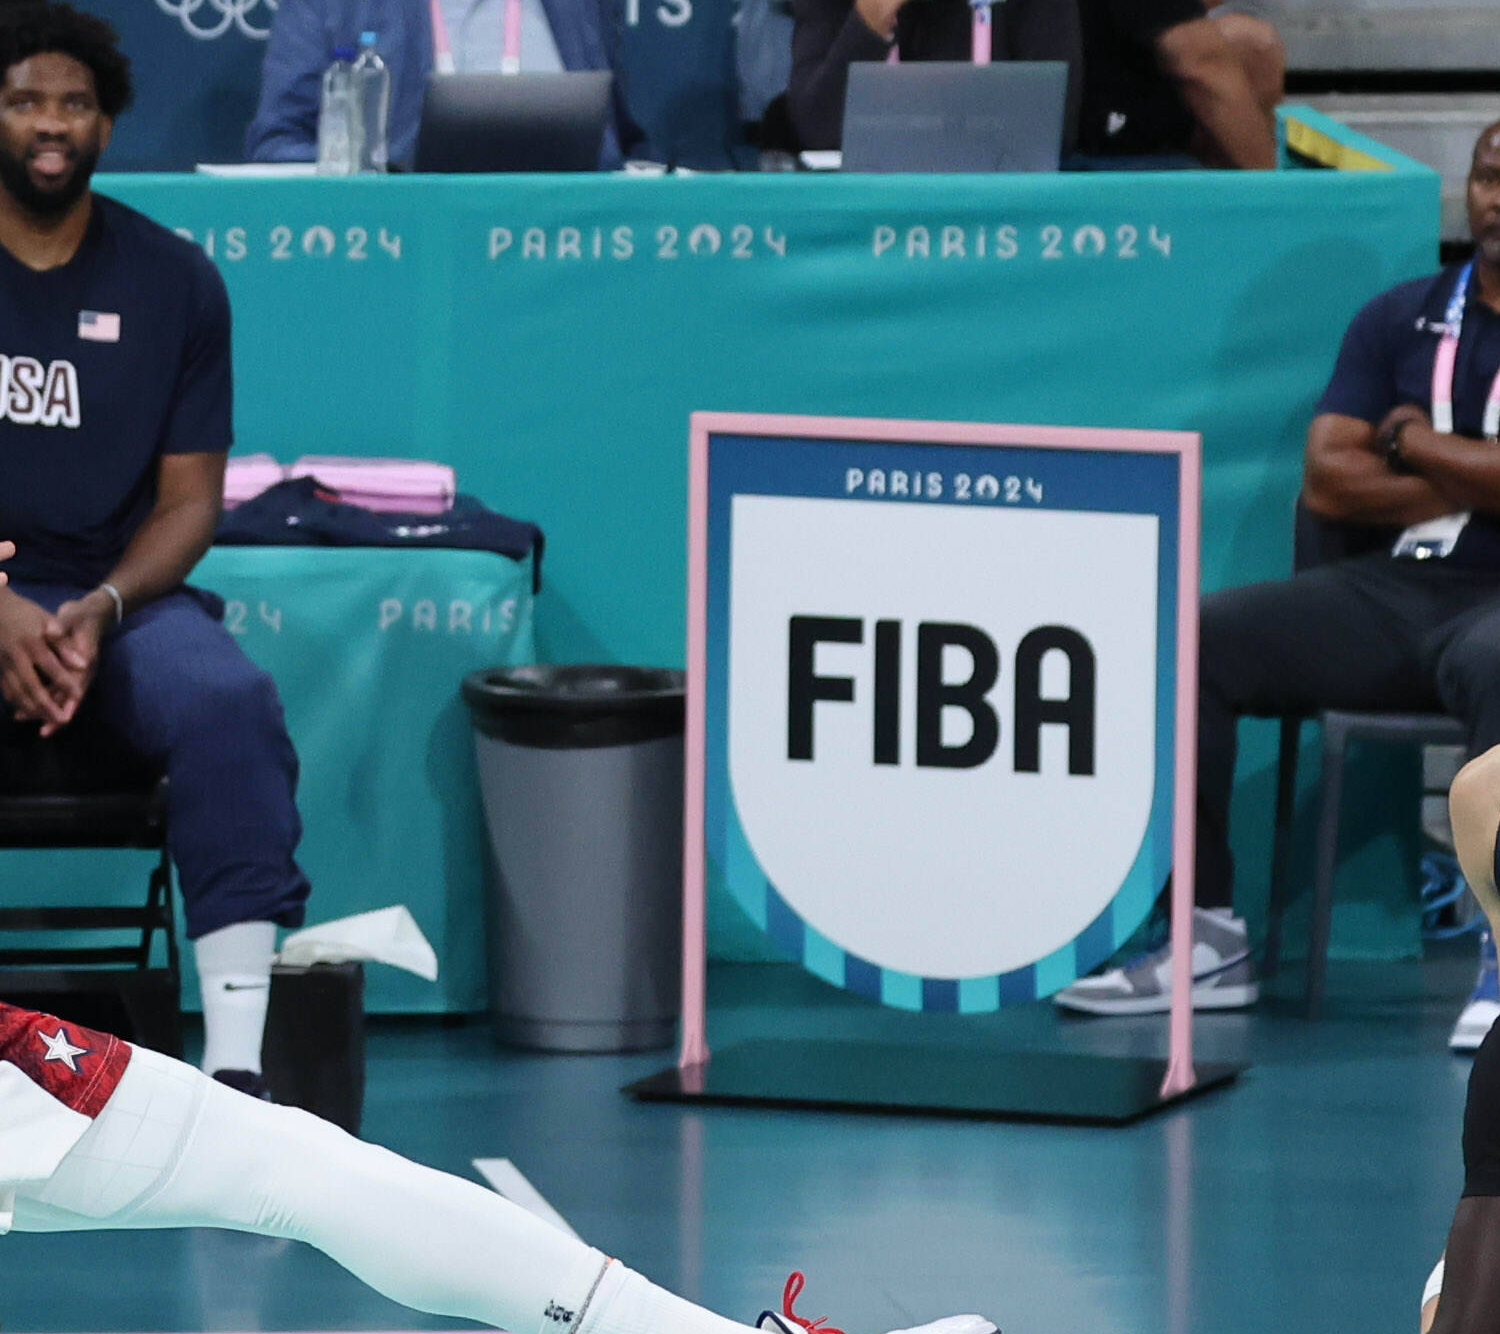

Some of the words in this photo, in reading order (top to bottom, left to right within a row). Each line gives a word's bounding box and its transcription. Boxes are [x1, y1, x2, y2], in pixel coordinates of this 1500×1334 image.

[270, 225, 402, 261] 2024
[656, 225, 788, 259] 2024
[1040, 225, 1172, 259] 2024
[955, 472, 1043, 503] 2024
[787, 614, 1096, 777] FIBA
